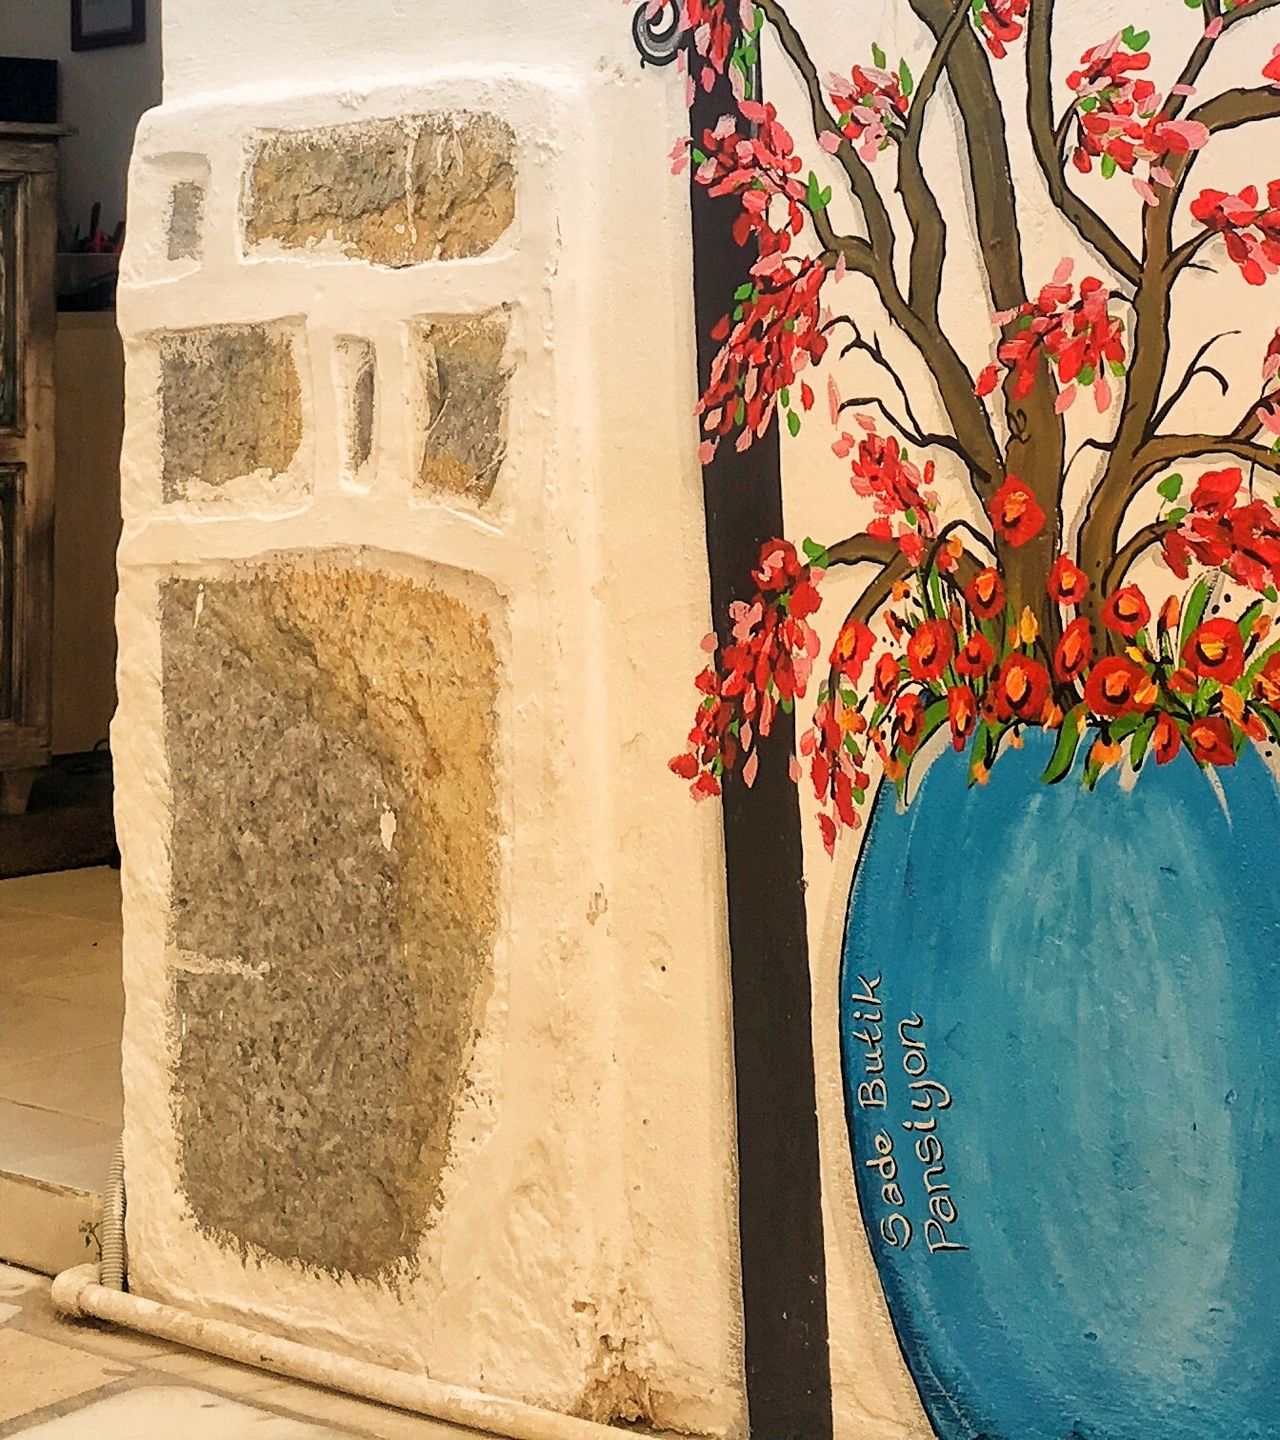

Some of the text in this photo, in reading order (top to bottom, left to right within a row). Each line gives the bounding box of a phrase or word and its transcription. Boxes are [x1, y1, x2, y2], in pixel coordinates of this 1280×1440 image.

[851, 969, 913, 1251] Sade Butik
[898, 1011, 970, 1254] Pansiyon
